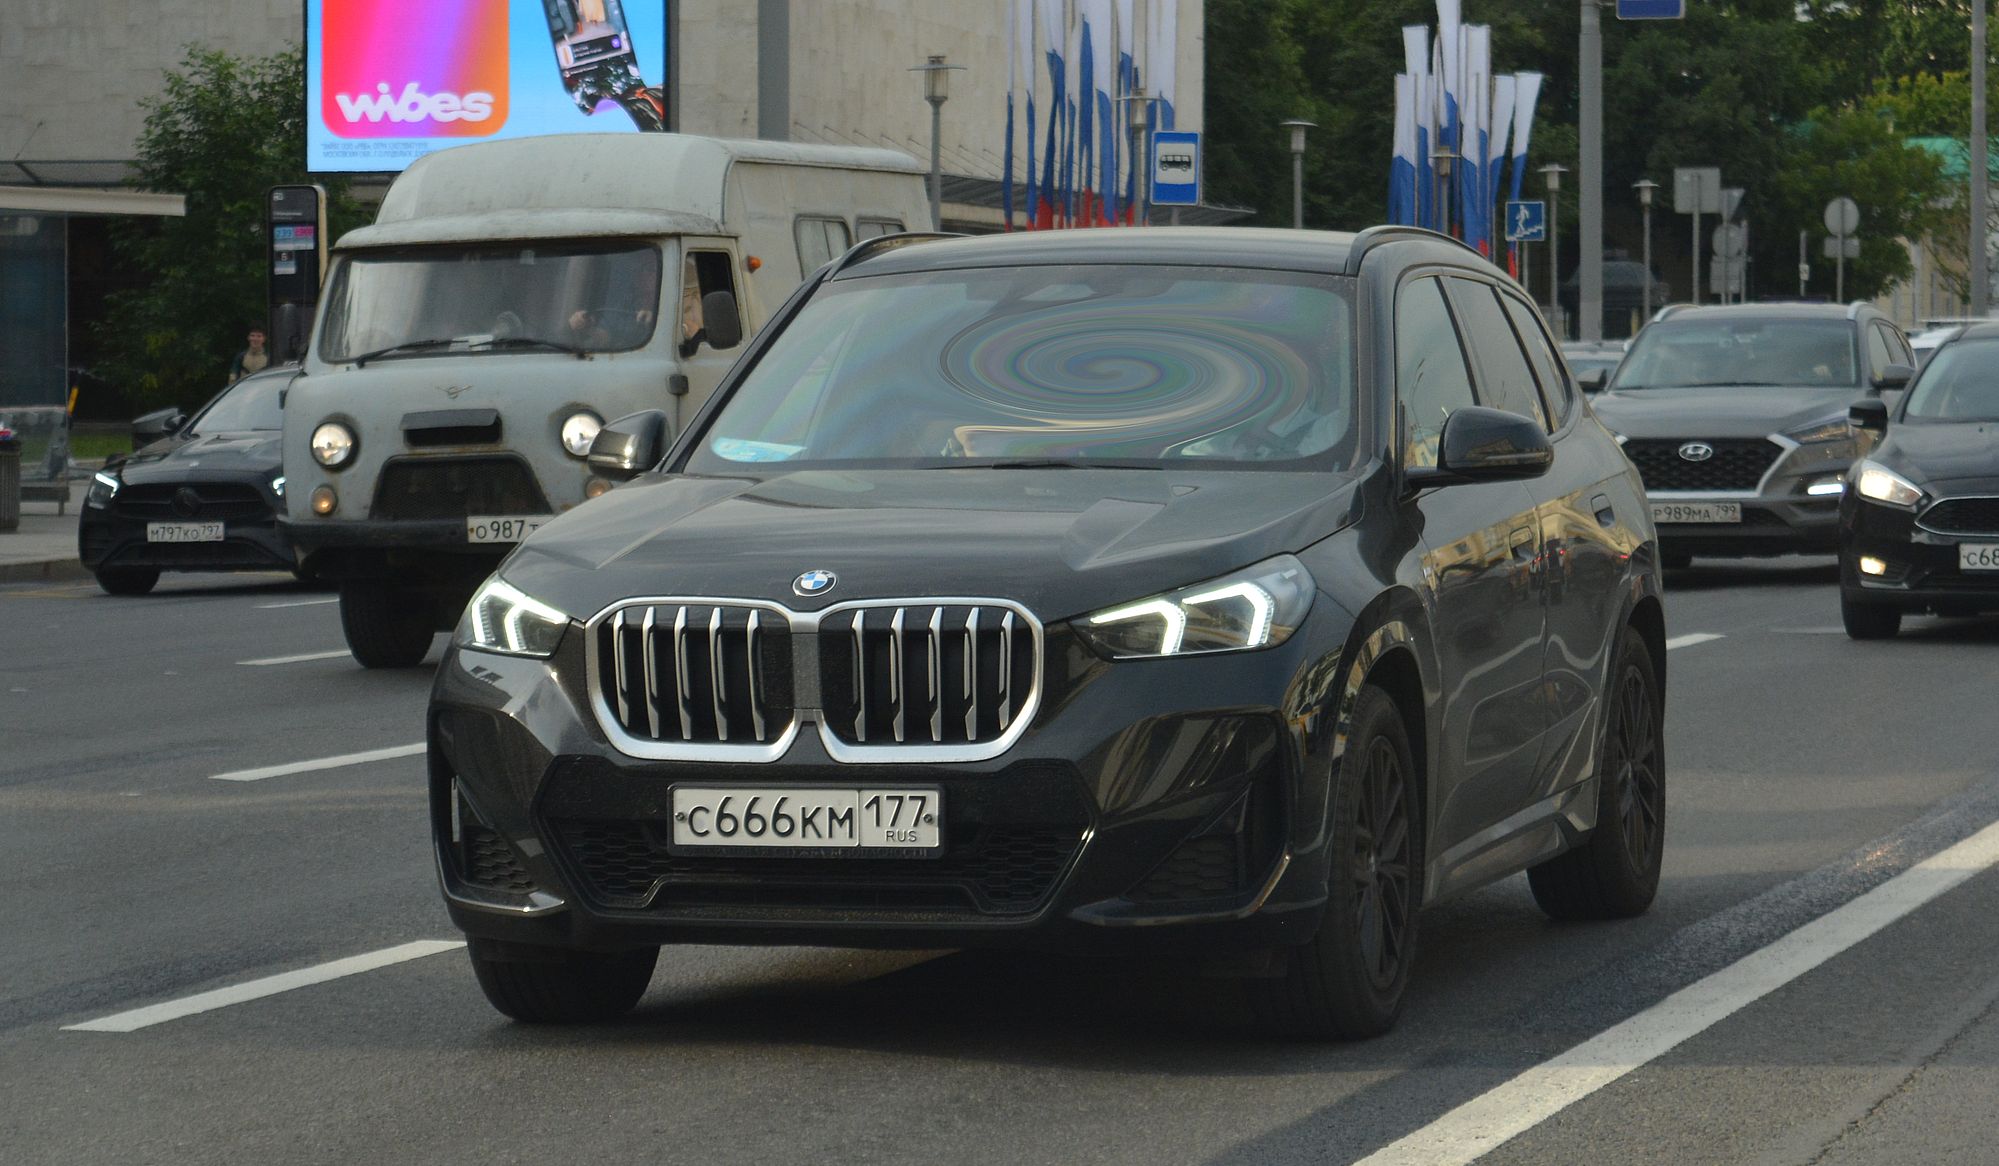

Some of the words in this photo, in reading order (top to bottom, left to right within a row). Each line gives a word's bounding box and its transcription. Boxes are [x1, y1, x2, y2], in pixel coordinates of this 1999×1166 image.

[335, 82, 495, 122] wibes
[687, 795, 854, 839] С666КМ
[863, 795, 928, 828] 177
[885, 830, 917, 843] RUS
